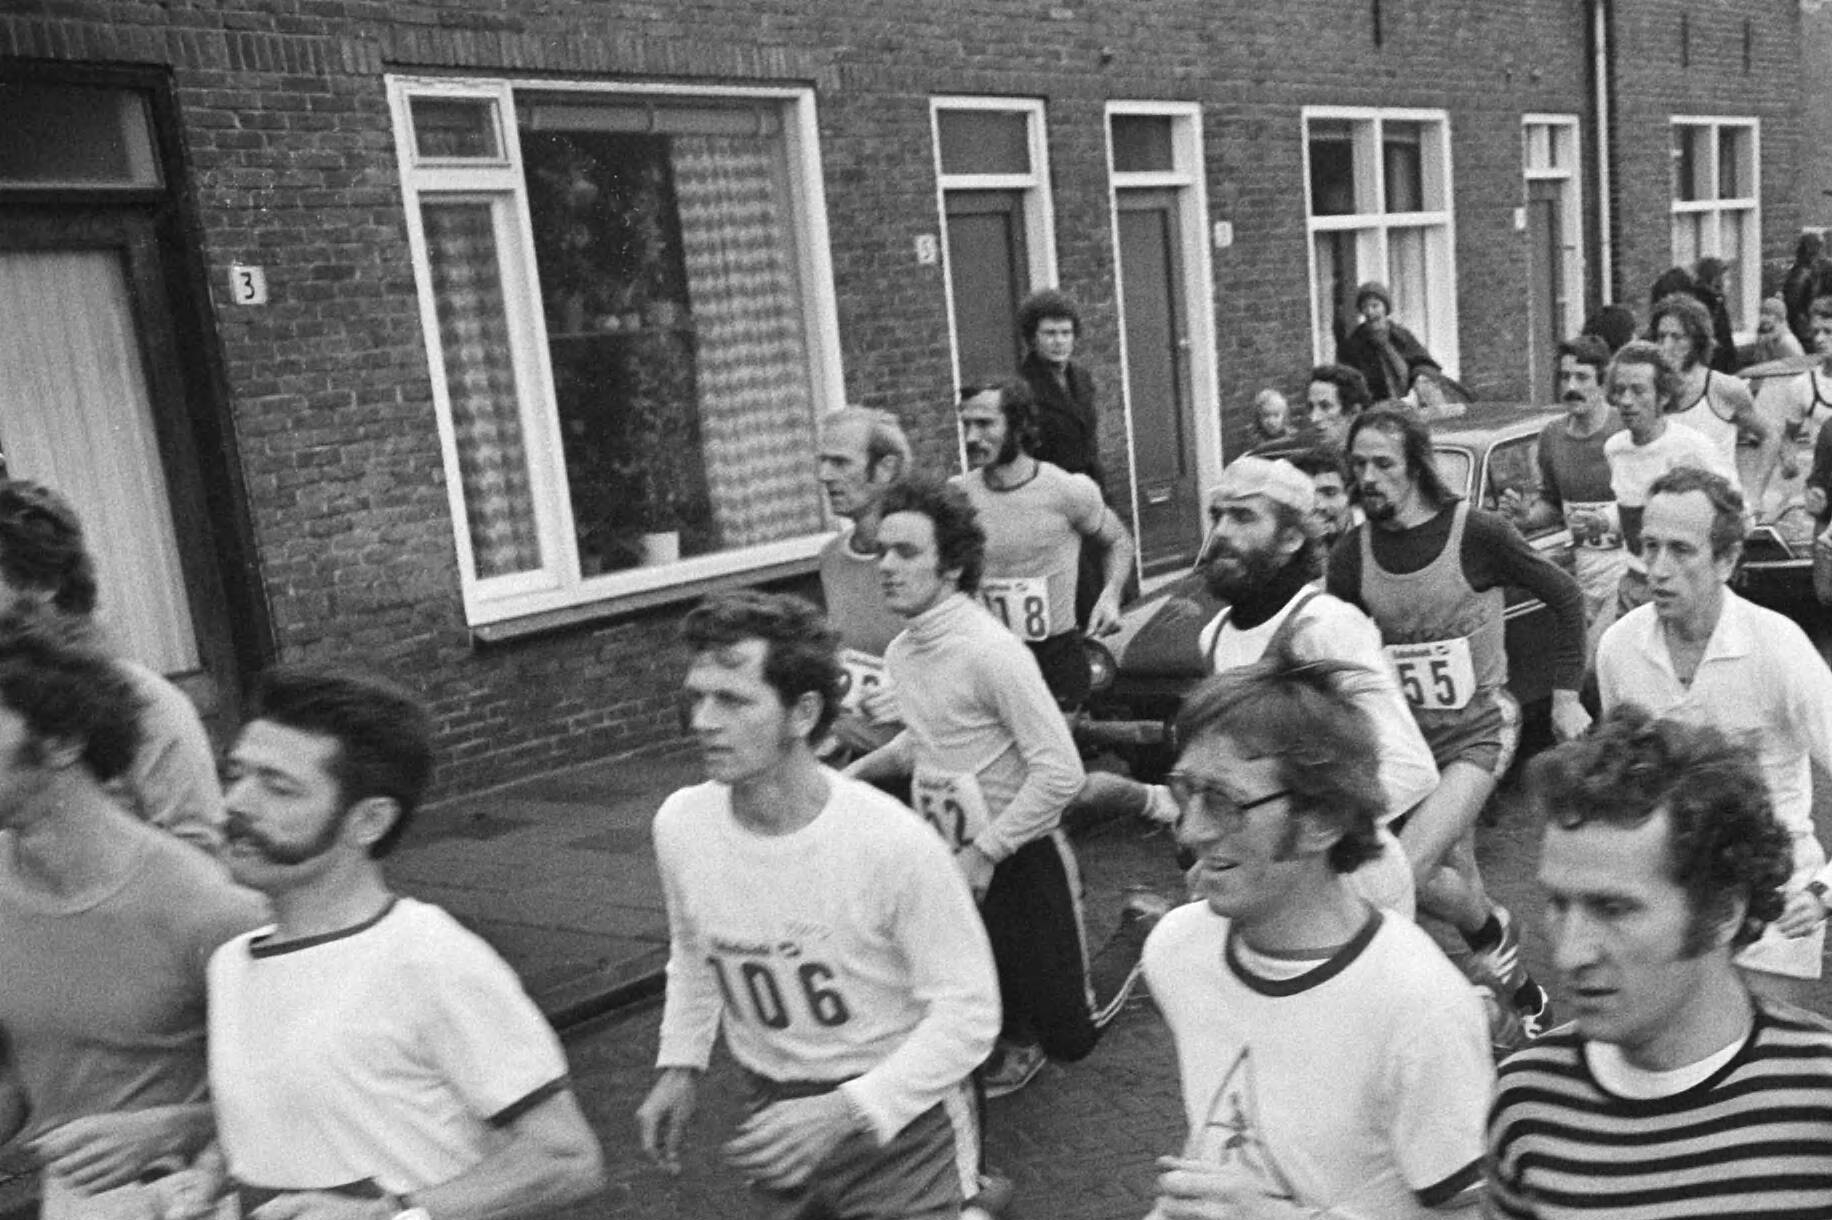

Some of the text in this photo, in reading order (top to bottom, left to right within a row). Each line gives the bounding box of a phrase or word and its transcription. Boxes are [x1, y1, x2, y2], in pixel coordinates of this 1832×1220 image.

[240, 271, 256, 300] 3
[1397, 660, 1457, 706] 55
[705, 955, 851, 1031] 106
